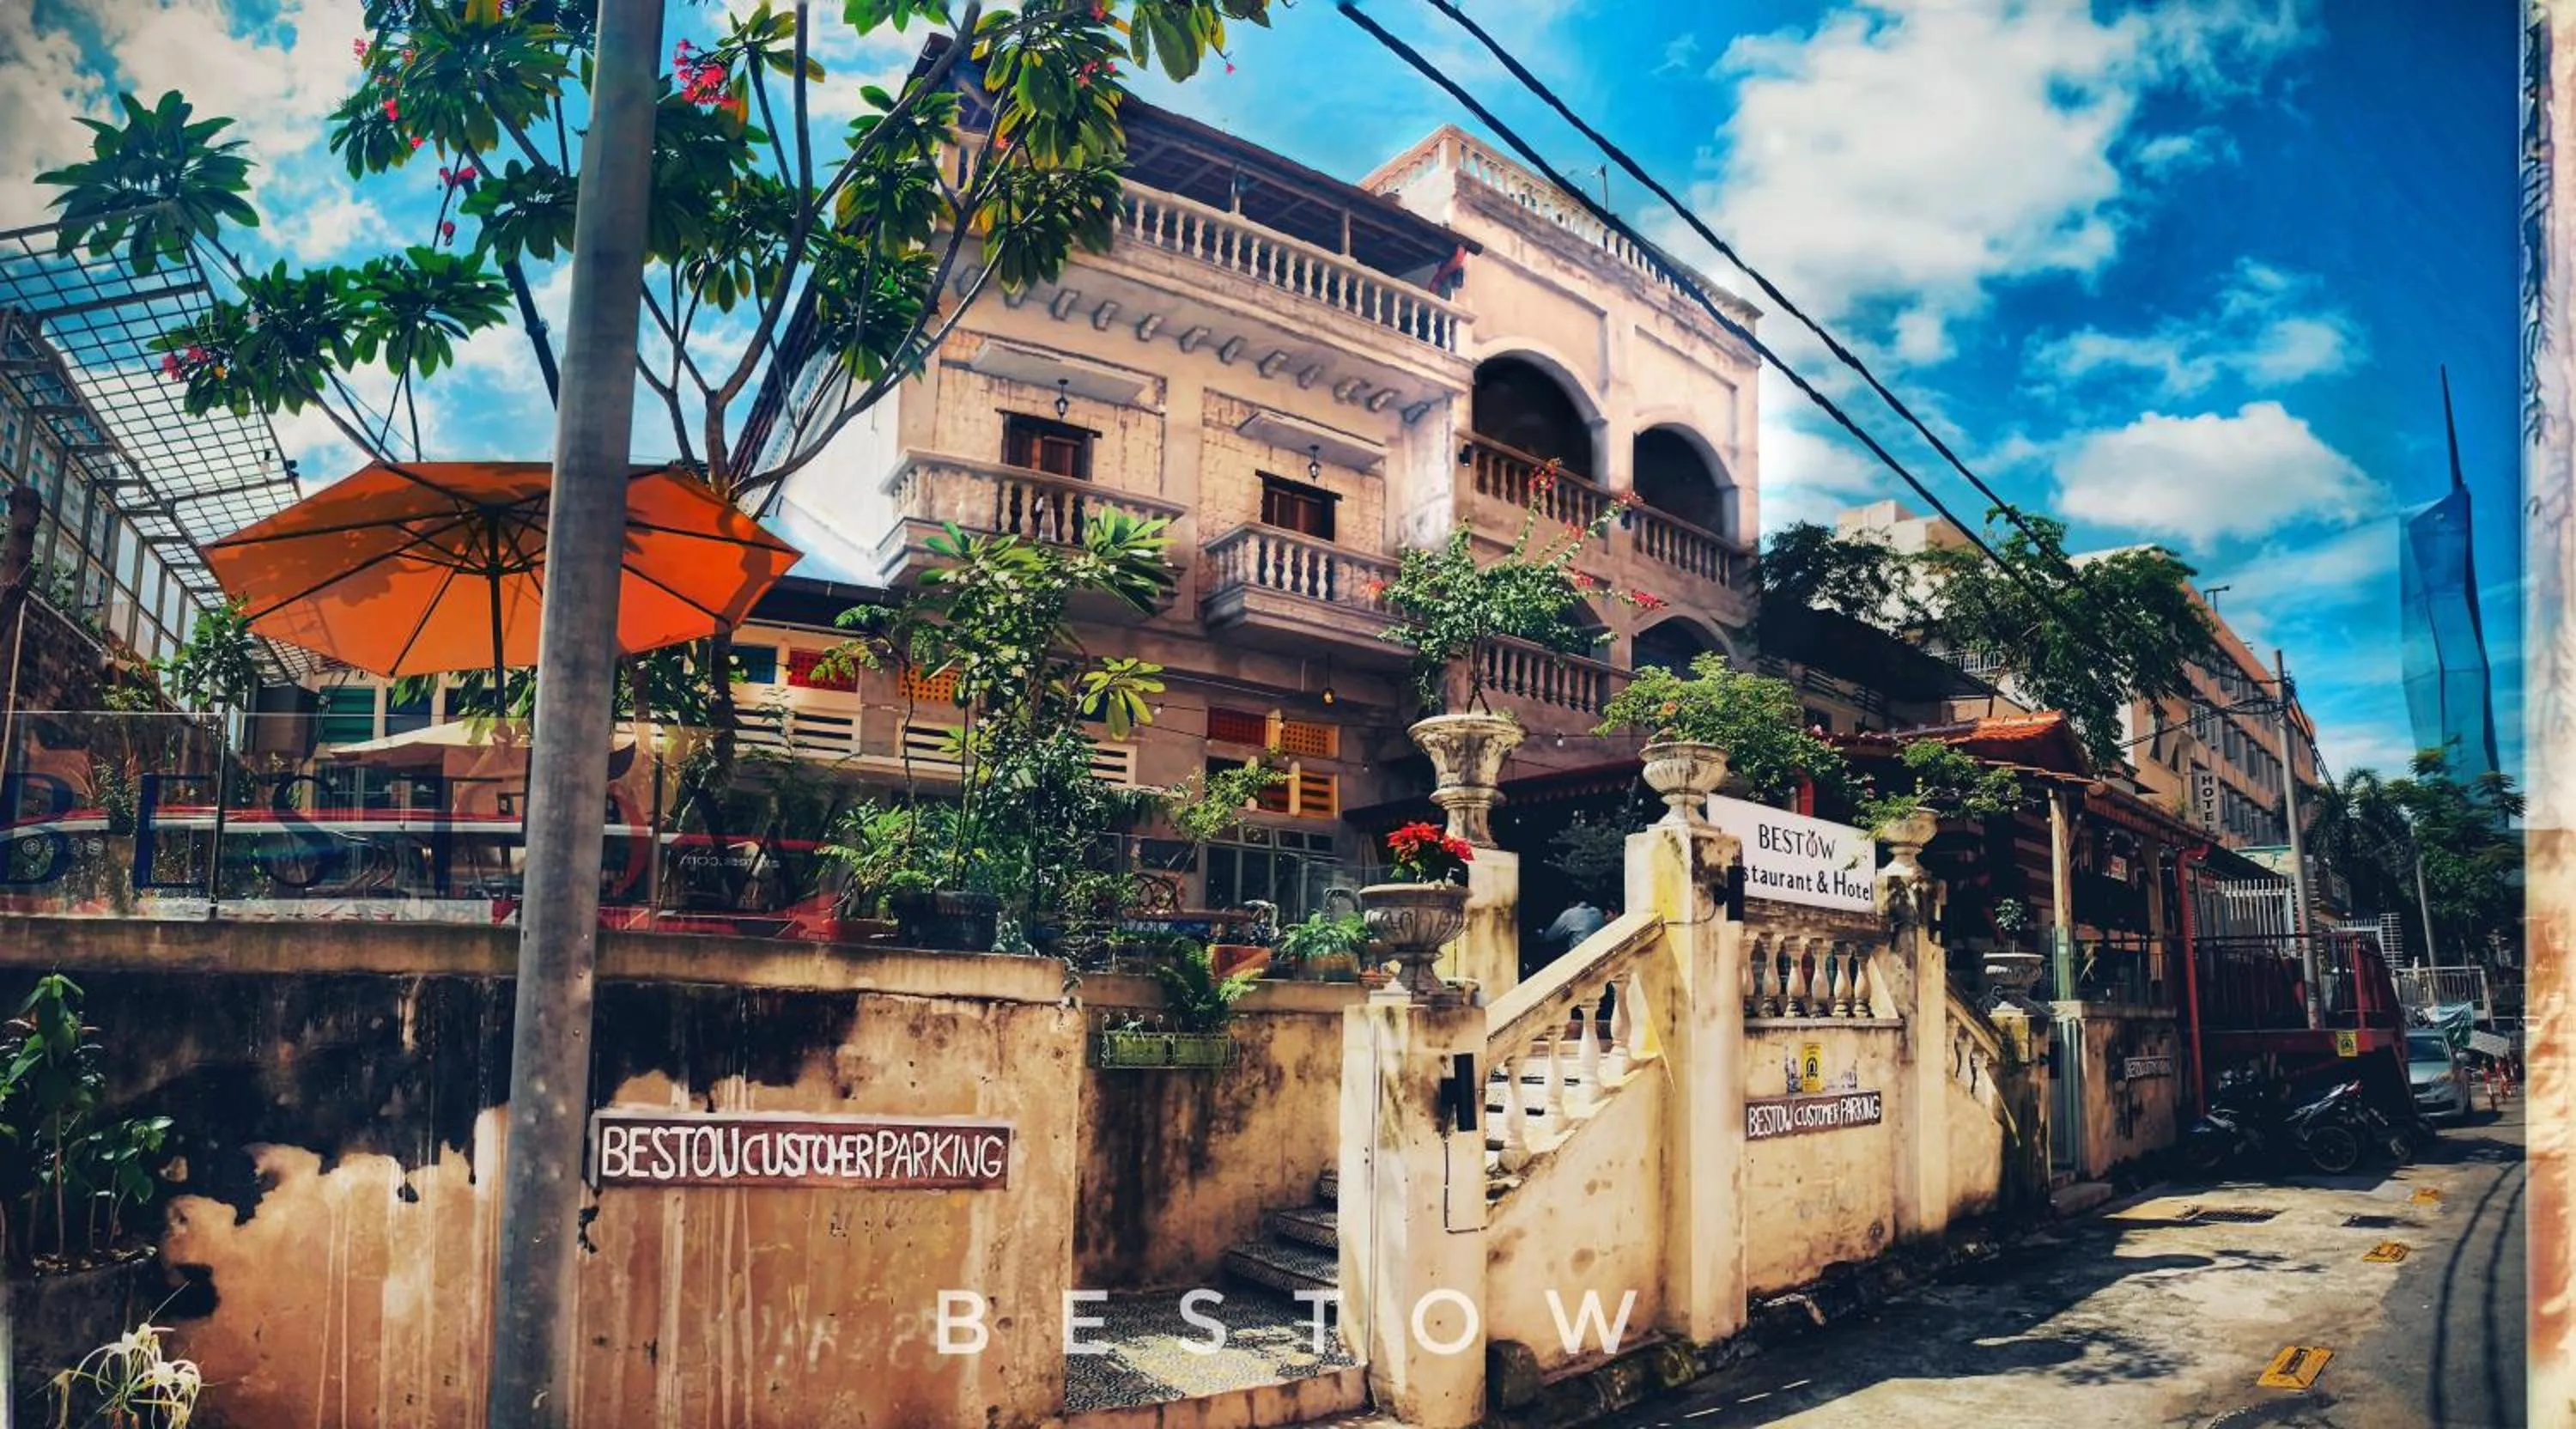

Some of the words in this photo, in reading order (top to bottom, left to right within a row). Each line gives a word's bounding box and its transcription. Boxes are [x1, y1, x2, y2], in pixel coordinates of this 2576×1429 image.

[2201, 775, 2215, 834] HOTEL
[1759, 824, 1837, 860] BESTOW
[1744, 865, 1813, 892] staurant
[1817, 870, 1829, 894] &
[1834, 870, 1874, 901] Hotel
[1840, 1095, 1880, 1125] PARKING
[875, 1129, 1004, 1180] PARKING
